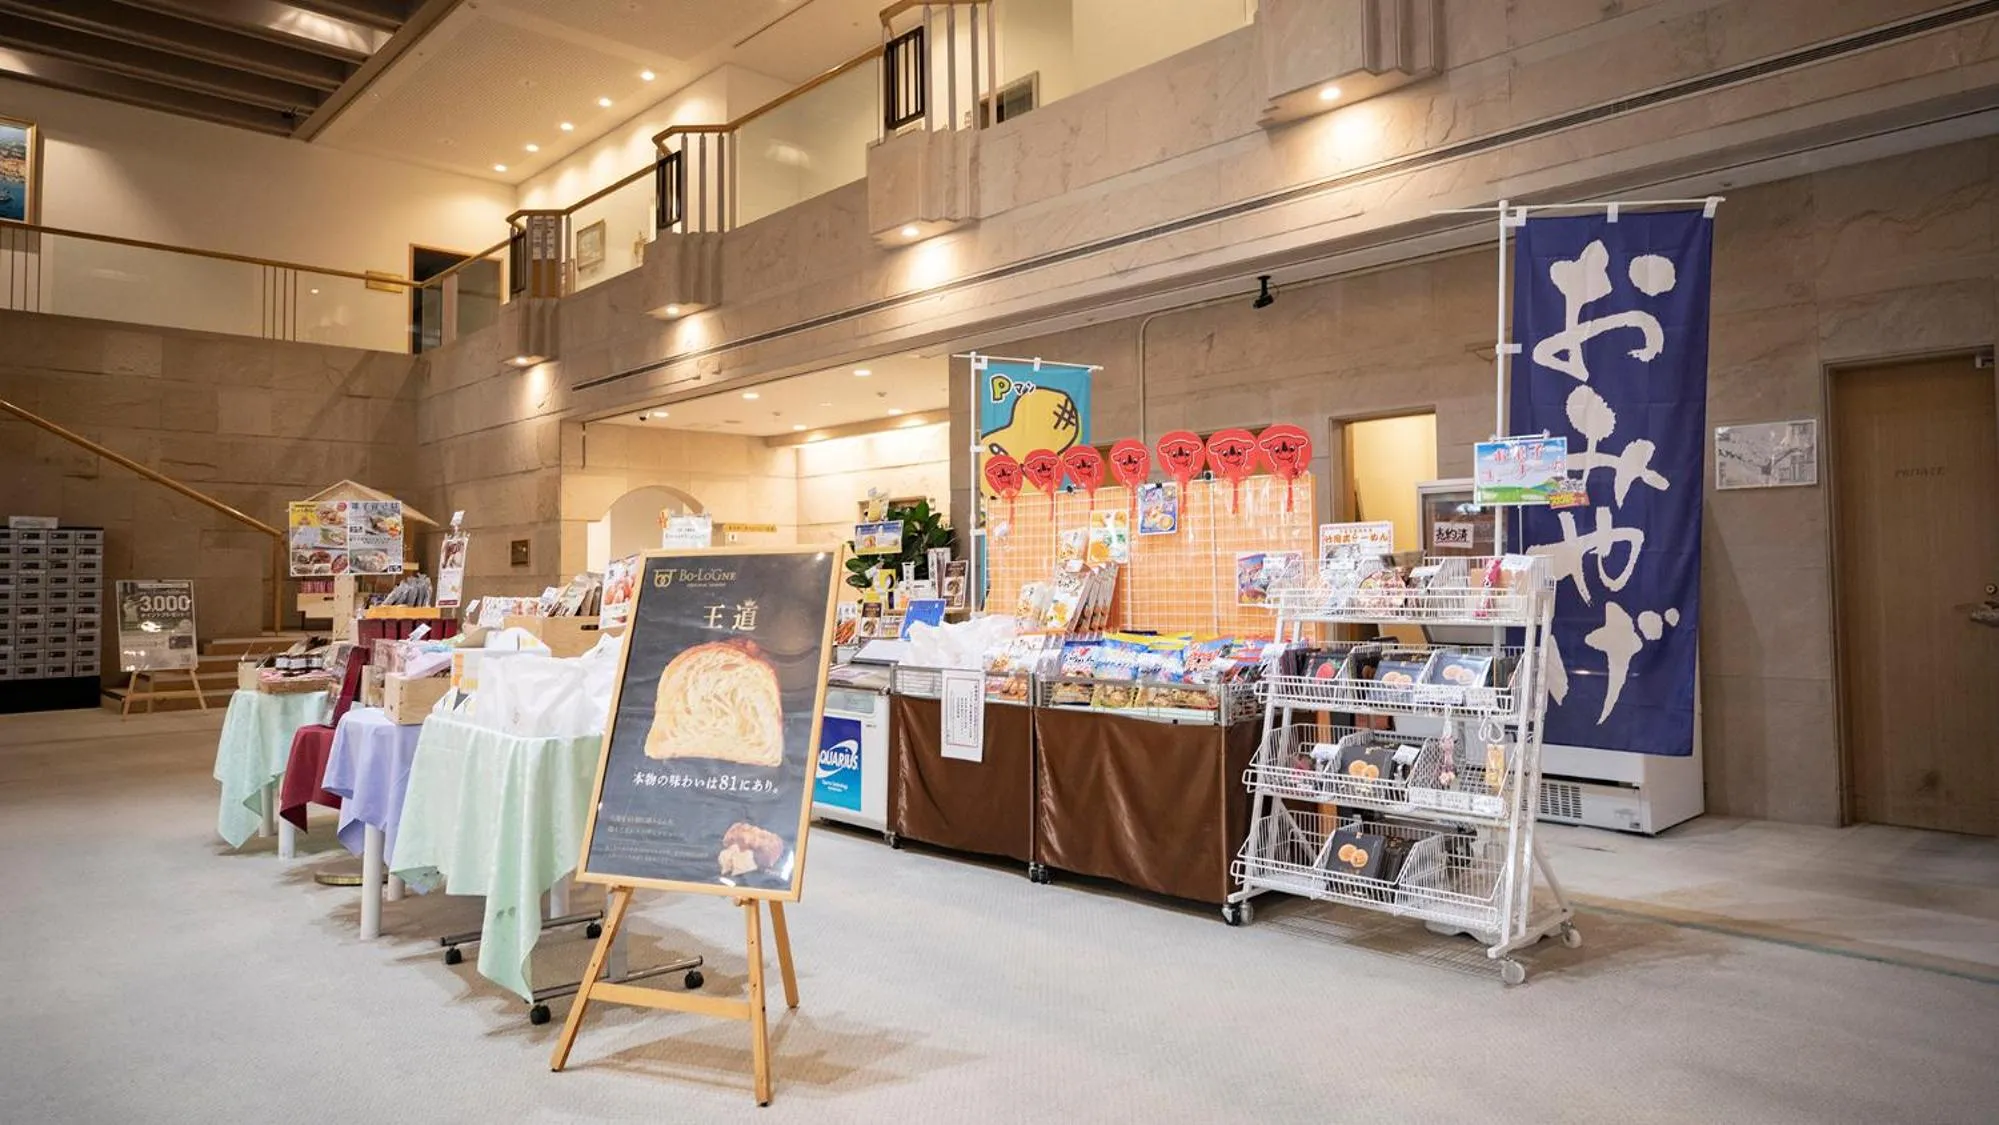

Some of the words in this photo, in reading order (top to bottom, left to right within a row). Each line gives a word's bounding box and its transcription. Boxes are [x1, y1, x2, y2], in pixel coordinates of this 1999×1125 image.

[1525, 238, 1680, 726] おみやげ
[139, 595, 190, 612] 3,000
[703, 600, 759, 631] 王道
[819, 750, 859, 770] QUARIUS
[632, 771, 780, 795] 本物の味わいは81にあり。
